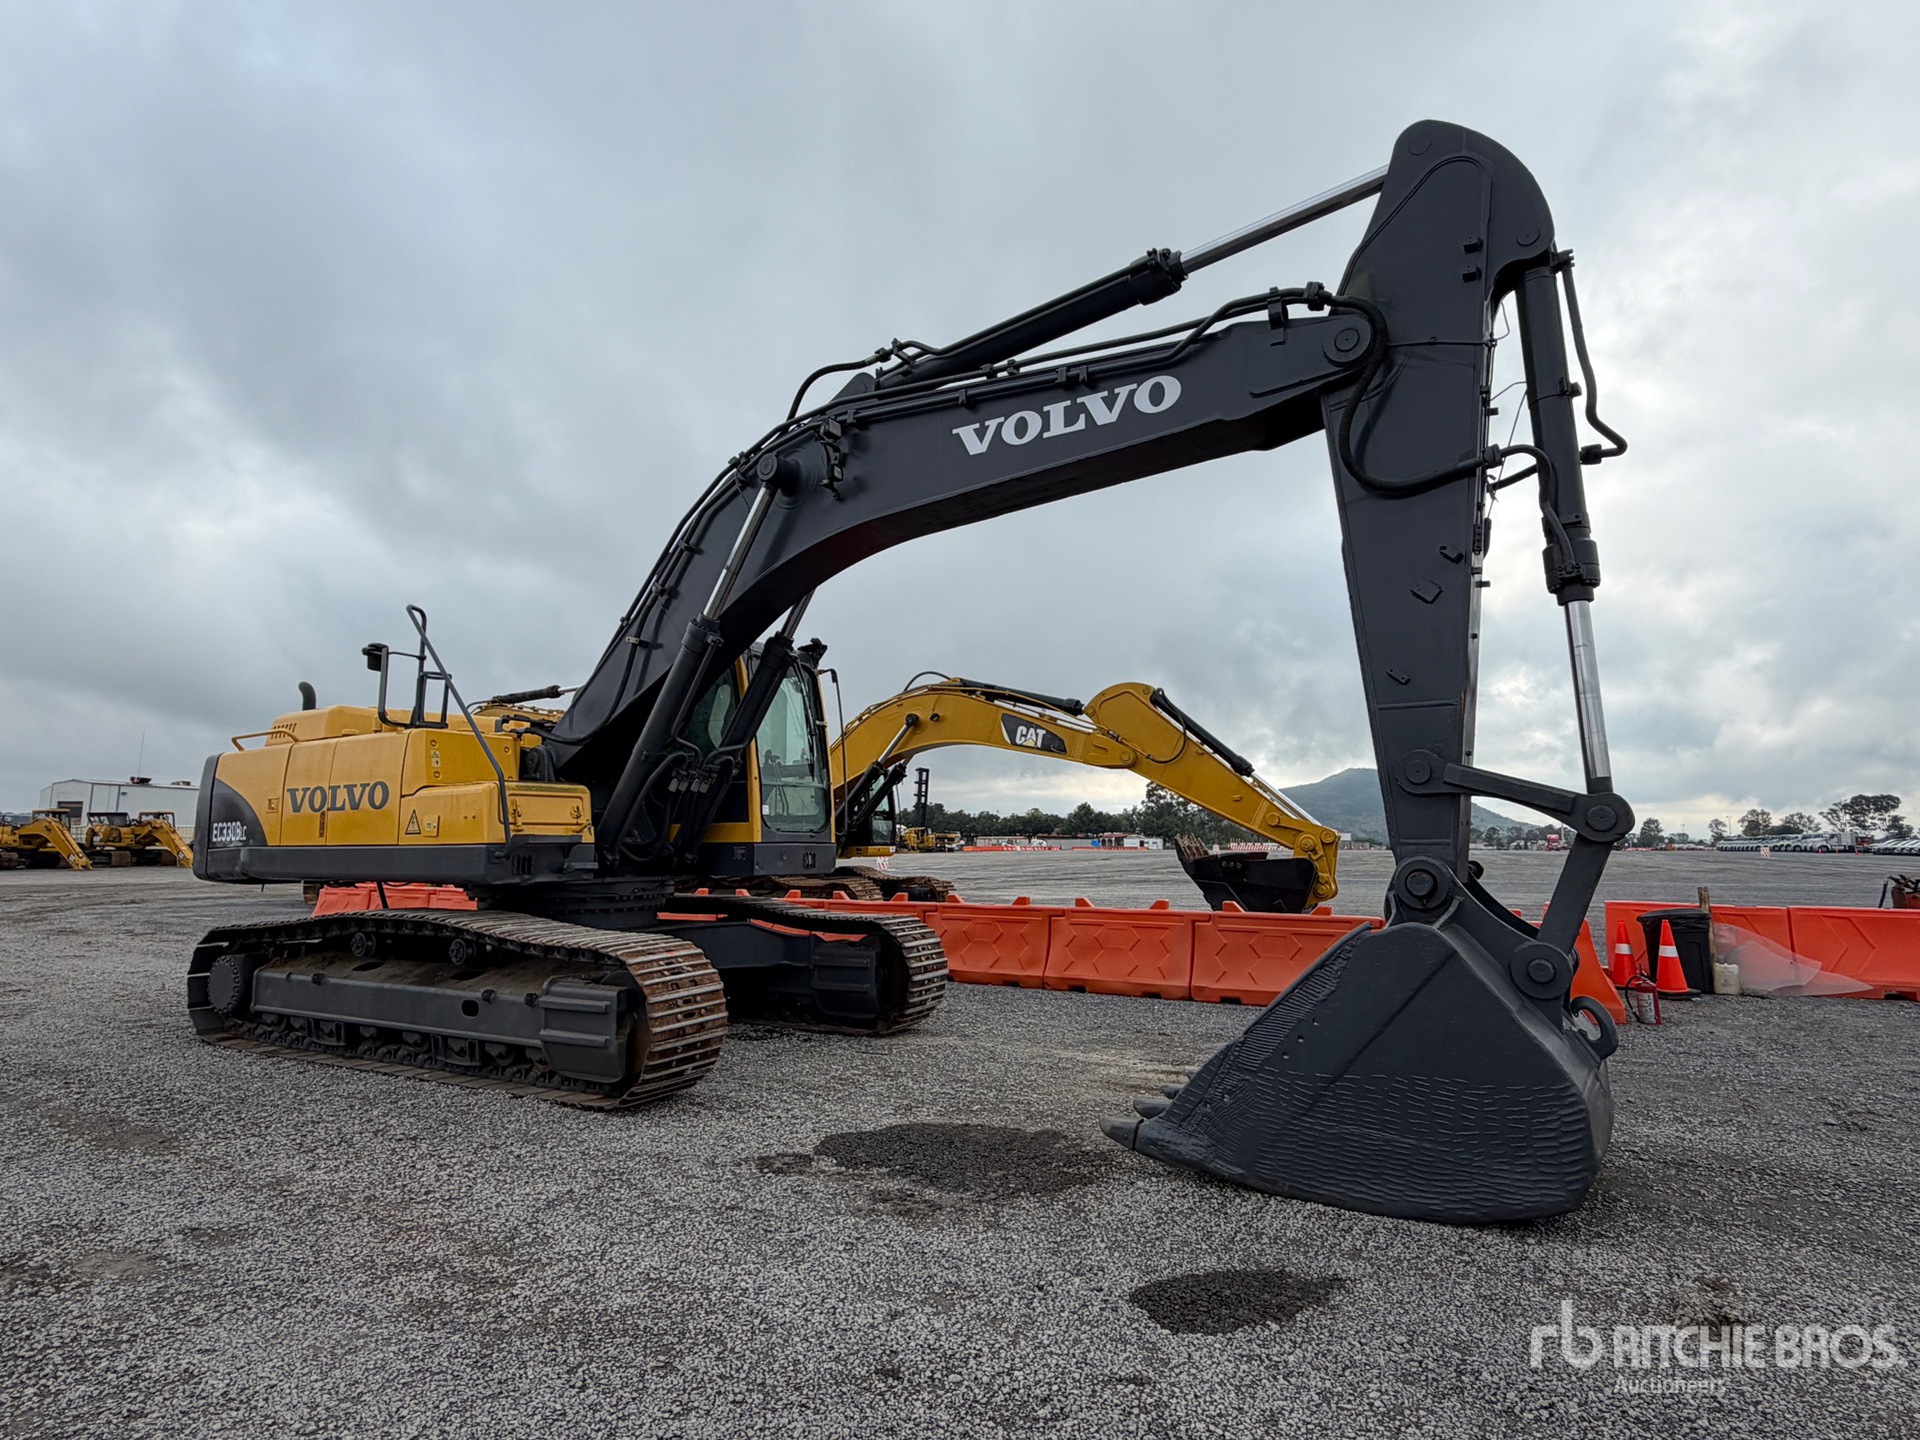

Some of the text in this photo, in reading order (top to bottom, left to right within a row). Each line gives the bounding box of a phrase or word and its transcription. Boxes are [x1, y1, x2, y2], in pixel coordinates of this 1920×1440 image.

[952, 375, 1182, 456] VOLVO
[1015, 725, 1047, 749] CAT
[286, 780, 390, 813] VOLVO
